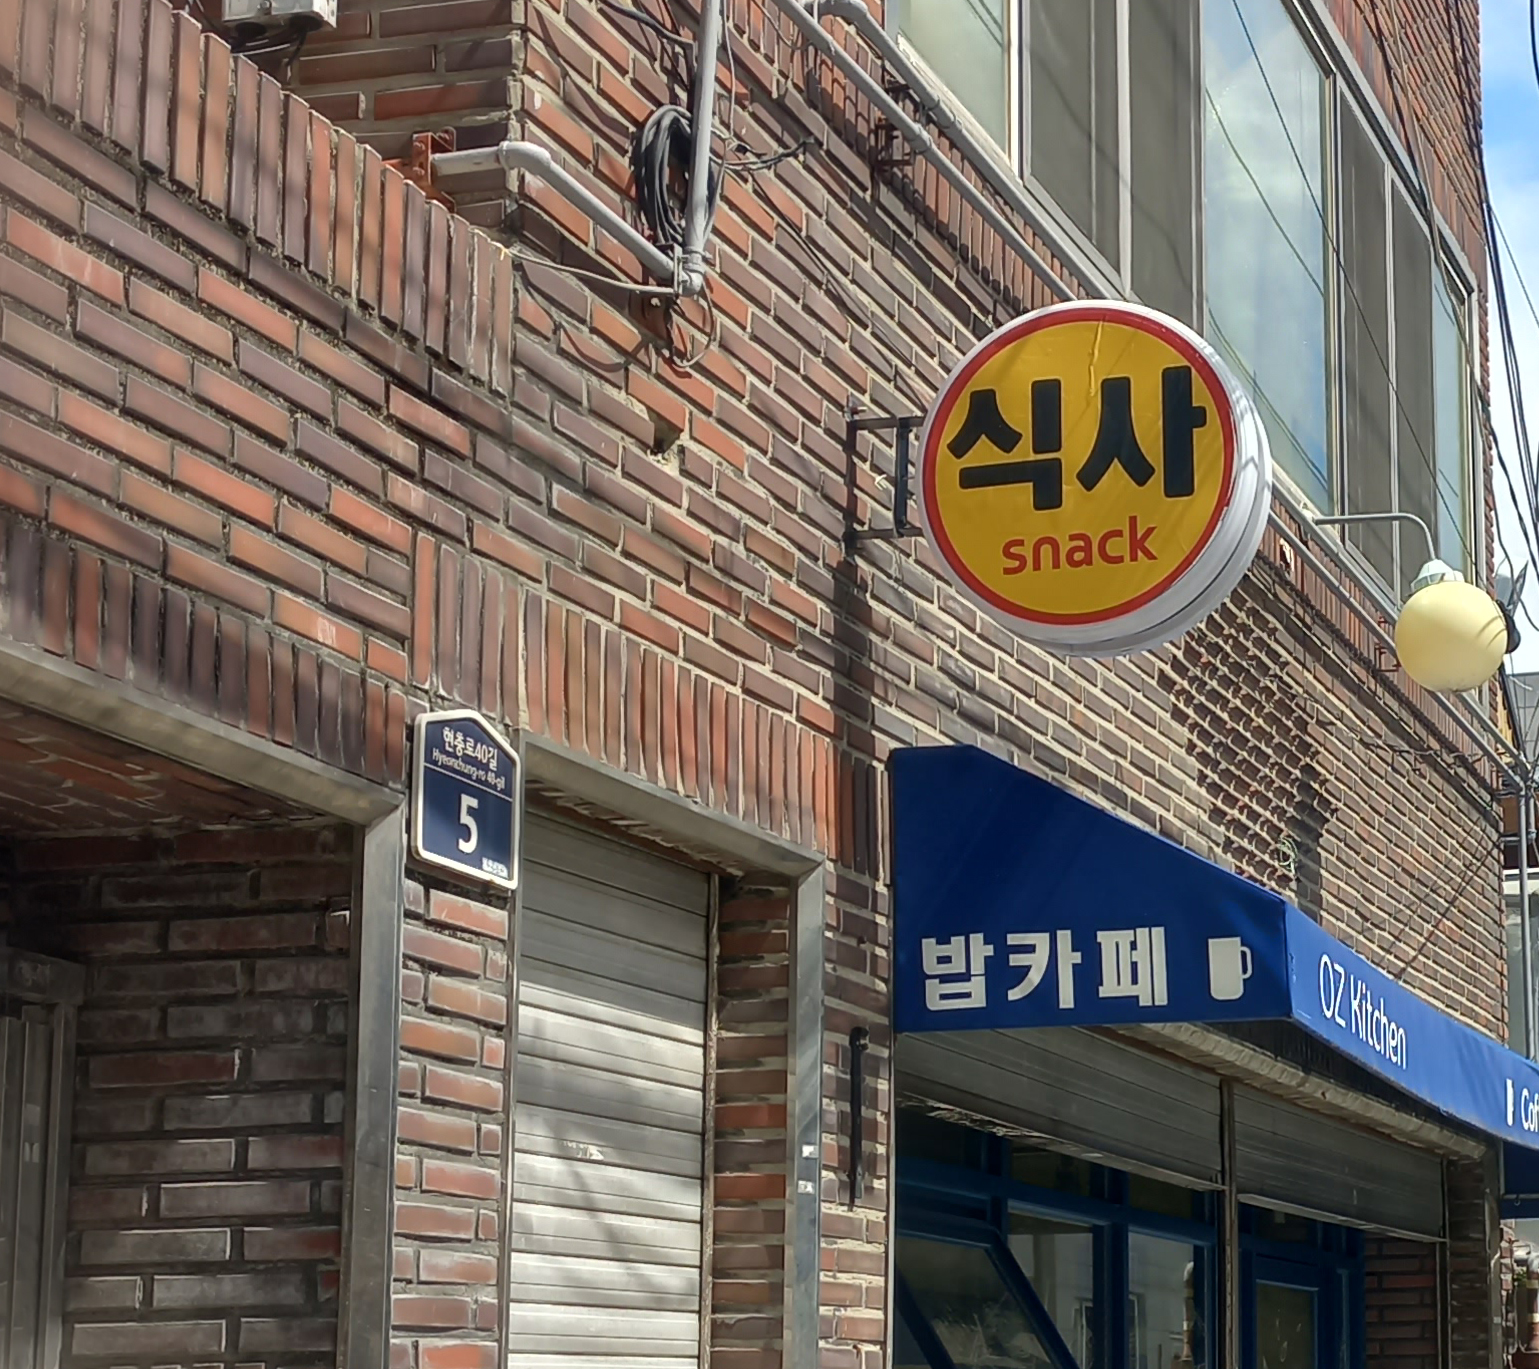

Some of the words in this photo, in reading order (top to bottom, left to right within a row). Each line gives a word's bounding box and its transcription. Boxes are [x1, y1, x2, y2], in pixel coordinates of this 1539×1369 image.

[946, 365, 1207, 511] 식사
[1002, 515, 1158, 575] snack
[442, 726, 498, 771] 현충로40길
[457, 793, 479, 854] 5
[921, 926, 1168, 1011] 밥카페
[1319, 954, 1346, 1029] OZ
[1350, 974, 1407, 1070] Kitchen
